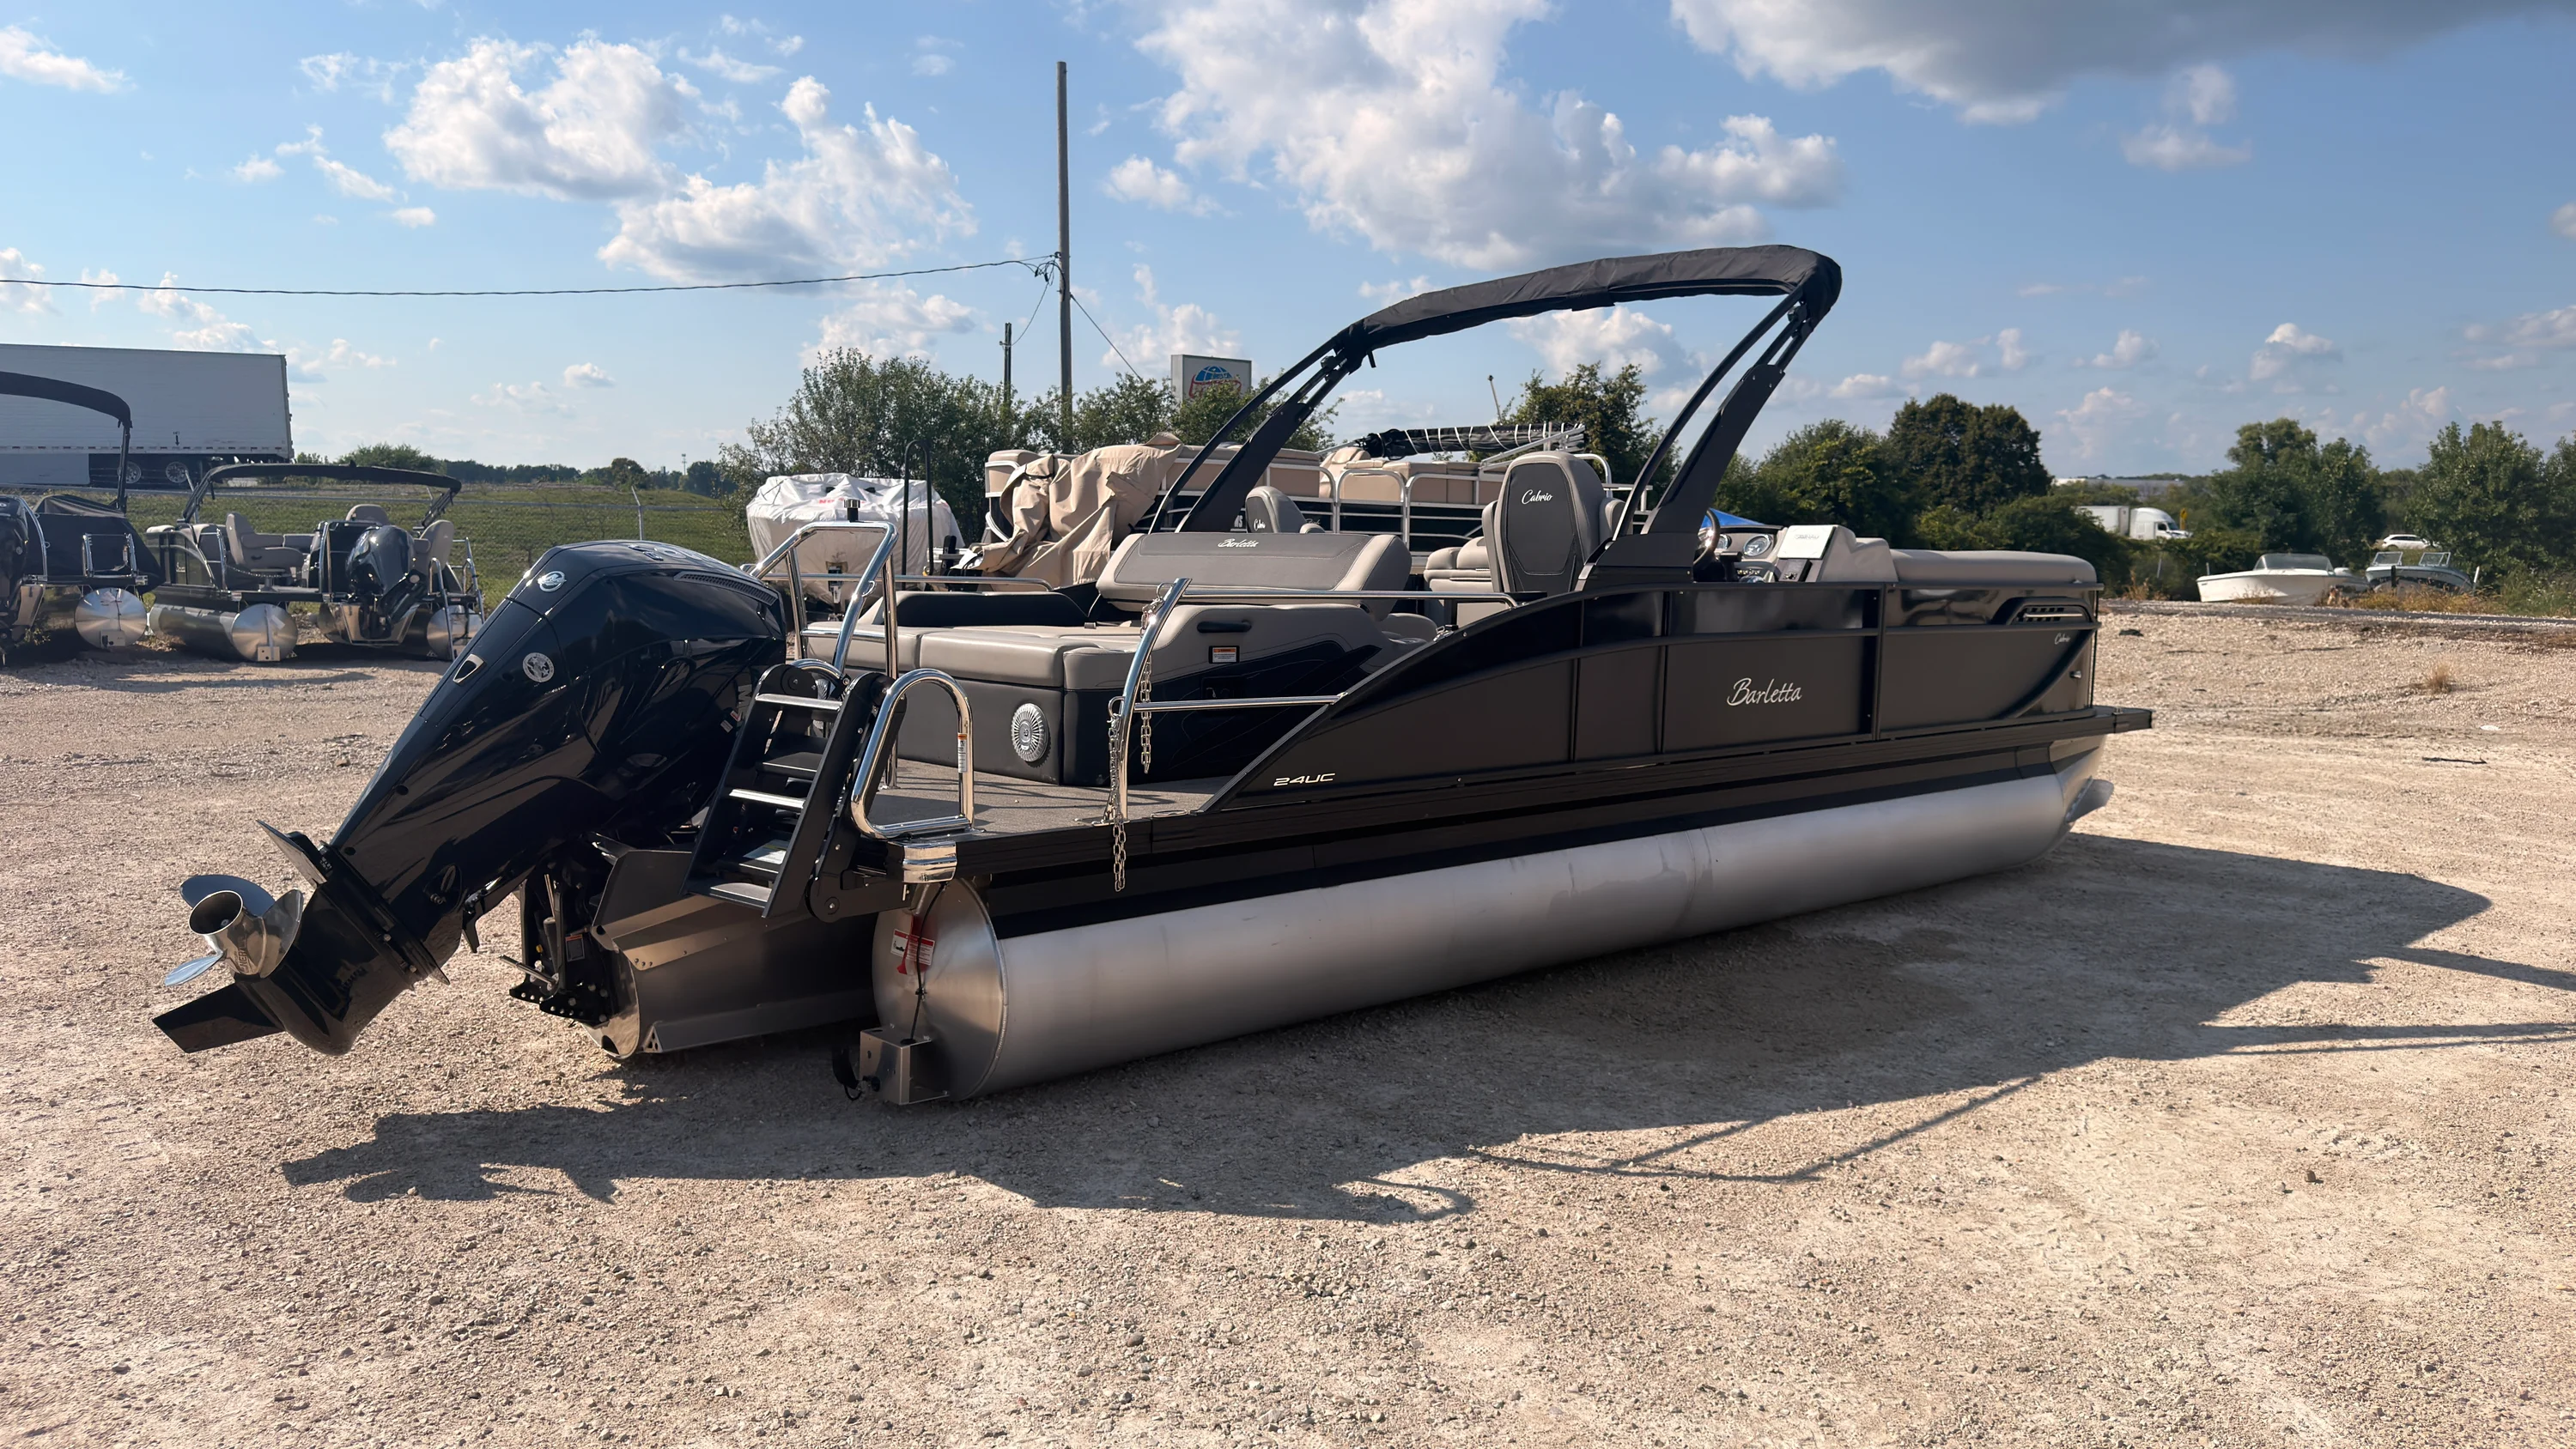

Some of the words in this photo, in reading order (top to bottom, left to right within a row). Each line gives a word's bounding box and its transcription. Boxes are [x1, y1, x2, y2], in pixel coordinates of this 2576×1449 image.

[1522, 489, 1552, 505] Cabrio
[1218, 538, 1259, 548] Barletta
[1727, 677, 1802, 706] Barletta
[1273, 773, 1336, 786] 24UC
